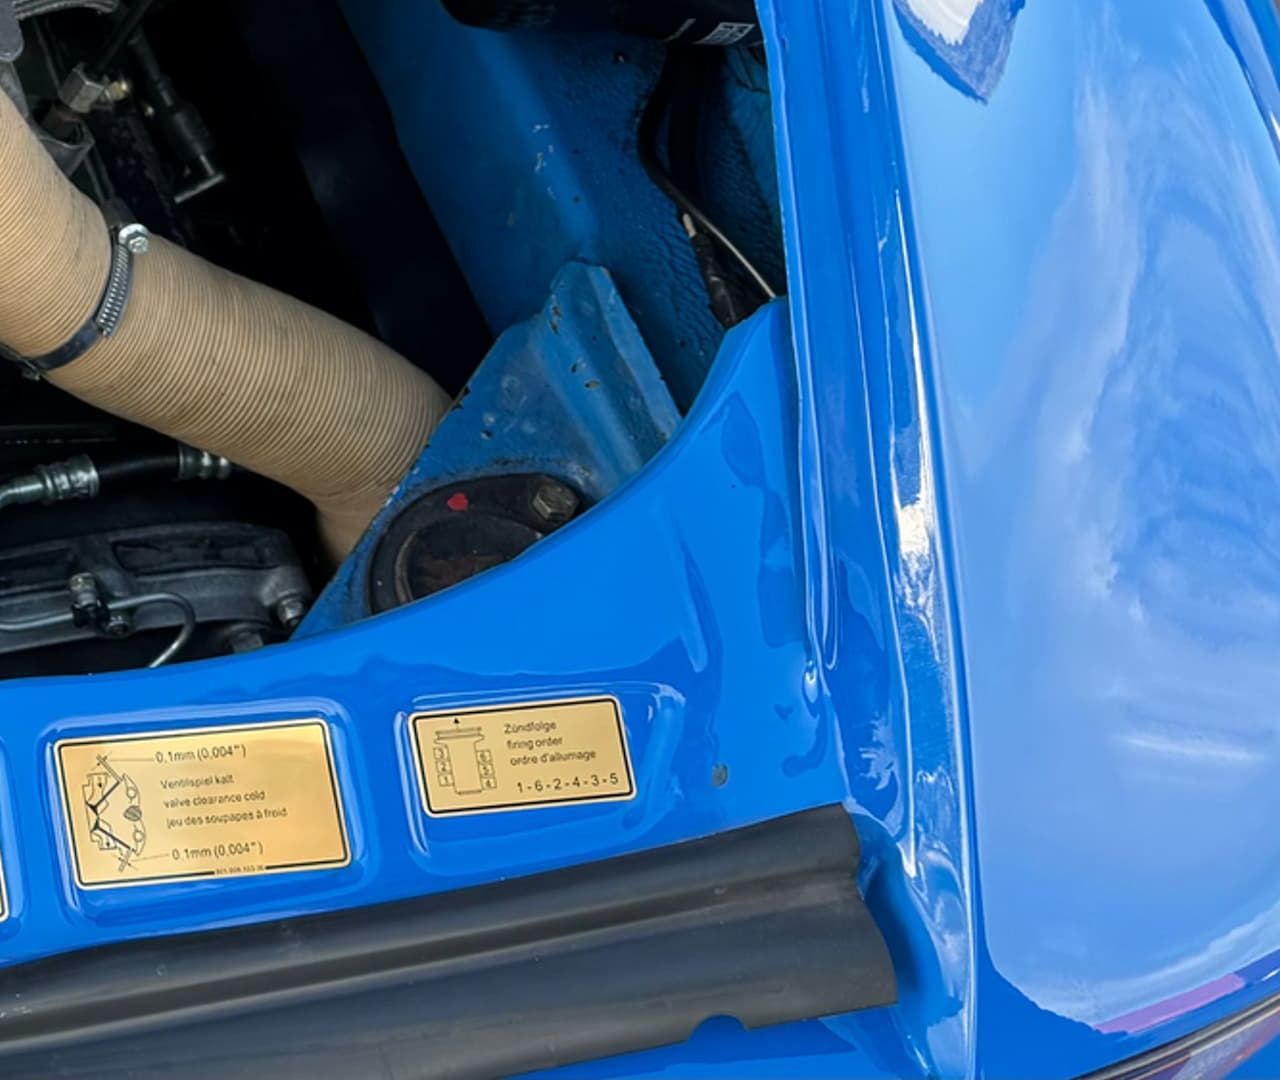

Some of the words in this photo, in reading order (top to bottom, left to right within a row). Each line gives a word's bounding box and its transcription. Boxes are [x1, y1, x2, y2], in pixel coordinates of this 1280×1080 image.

[507, 739, 533, 751] firing
[534, 737, 563, 747] order
[510, 754, 537, 766] ordre
[540, 749, 596, 763] d'allumage
[160, 776, 214, 790] Ventilspiel
[215, 775, 234, 786] kalt
[163, 797, 191, 809] valve
[192, 793, 242, 806] clearance
[244, 791, 265, 801] cold
[166, 817, 183, 829] jeu
[184, 816, 203, 826] des
[263, 807, 288, 818] froid
